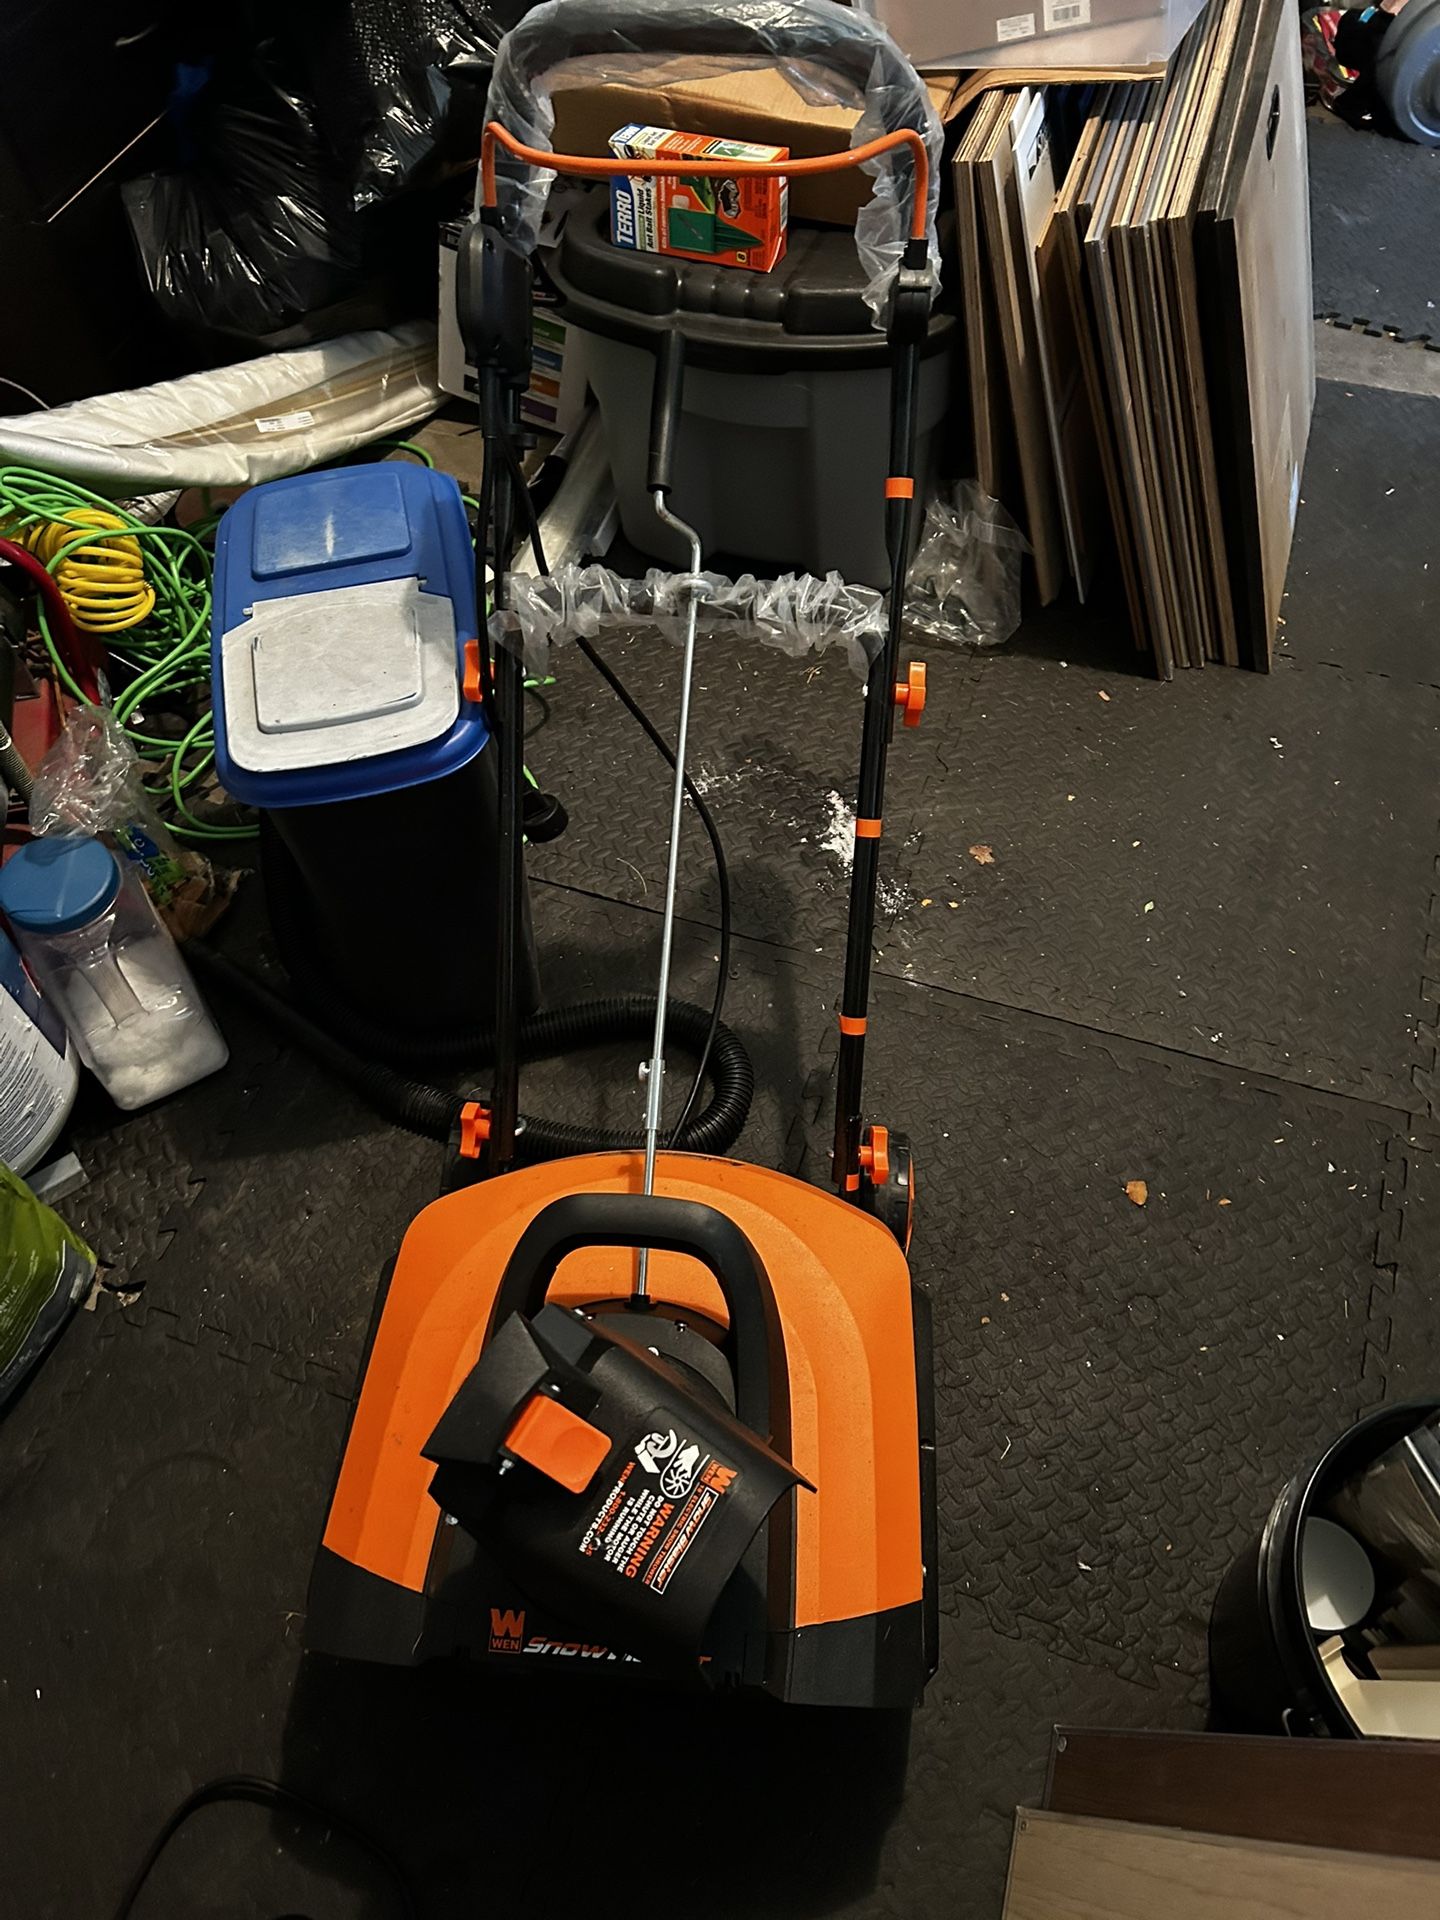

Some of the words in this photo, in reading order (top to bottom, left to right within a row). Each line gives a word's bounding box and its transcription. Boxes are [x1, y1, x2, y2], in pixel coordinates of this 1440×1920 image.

[616, 190, 634, 244] TERRO
[704, 1462, 720, 1482] WEN
[578, 1461, 636, 1553] WENPRODUCTS.COM
[626, 1496, 636, 1507] IS
[631, 1488, 650, 1515] WHILE
[635, 1494, 656, 1523] CHUTE
[653, 1495, 665, 1509] DO
[676, 1495, 699, 1529] ELECTRIC
[604, 1506, 630, 1544] RUNNING
[621, 1514, 634, 1532] THE
[628, 1522, 639, 1536] OR
[643, 1508, 657, 1527] NOT
[603, 1531, 624, 1562] MOTOR
[611, 1535, 631, 1565] AUGER
[623, 1500, 675, 1579] WARNING
[626, 1525, 647, 1555] TOUCH
[664, 1528, 679, 1550] SNOW
[616, 1555, 629, 1573] THE
[644, 1550, 666, 1585] THROWER
[492, 1638, 519, 1650] WEN
